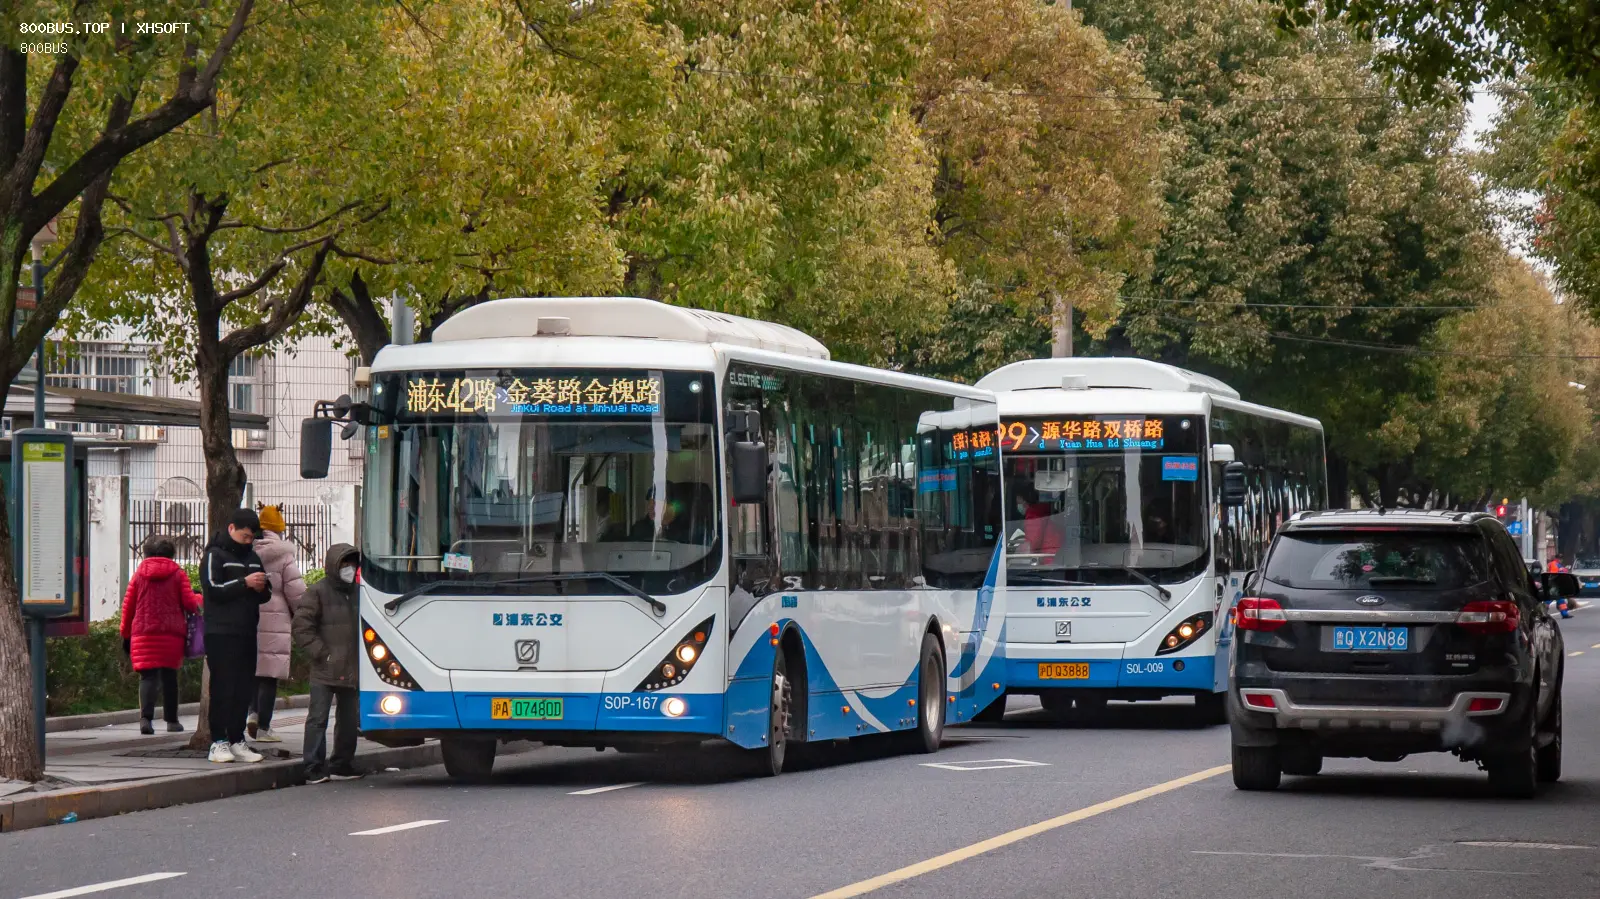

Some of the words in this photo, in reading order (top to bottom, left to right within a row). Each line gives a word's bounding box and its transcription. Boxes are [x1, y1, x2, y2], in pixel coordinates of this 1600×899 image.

[407, 378, 497, 413] 浦东42路
[506, 377, 661, 405] 金葵路金槐路
[543, 403, 571, 413] Road
[575, 404, 588, 413] at
[591, 403, 627, 413] Jinhuai
[630, 403, 660, 413] Road
[1041, 420, 1164, 440] 源华路双桥路
[1060, 439, 1082, 449] Yuan
[1086, 438, 1104, 448] Hua
[1046, 596, 1092, 608] 浦东公交
[505, 612, 563, 626] 浦东公交
